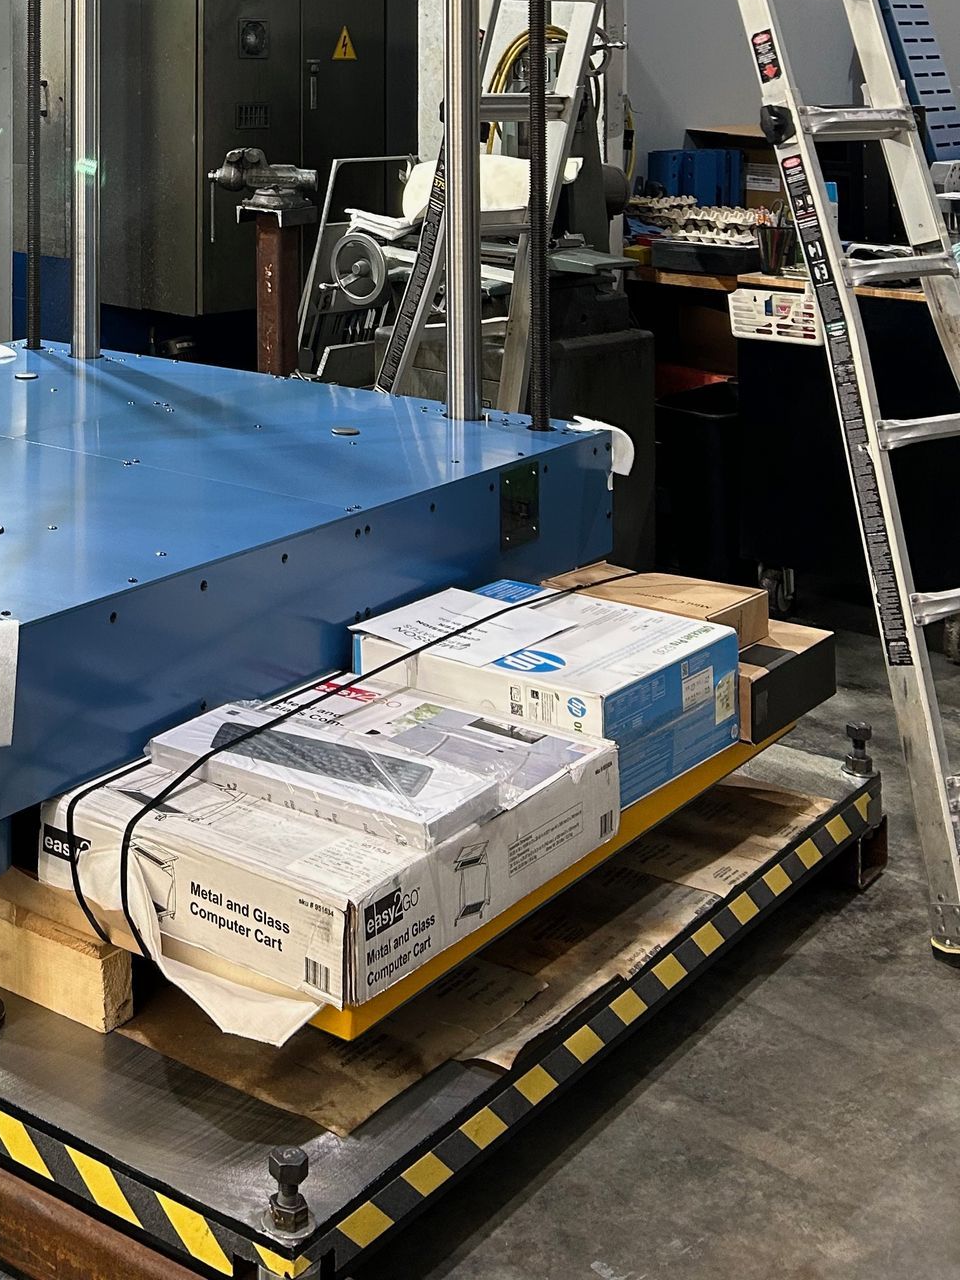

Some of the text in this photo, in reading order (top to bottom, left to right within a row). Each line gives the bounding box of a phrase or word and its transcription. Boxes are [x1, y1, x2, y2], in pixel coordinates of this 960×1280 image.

[319, 708, 344, 720] and
[567, 697, 587, 718] hp
[189, 902, 283, 952] Computer Cart
[190, 881, 291, 935] Metal and Glass
[366, 914, 436, 967] Metal and Glass
[366, 937, 432, 987] Computer Cart
